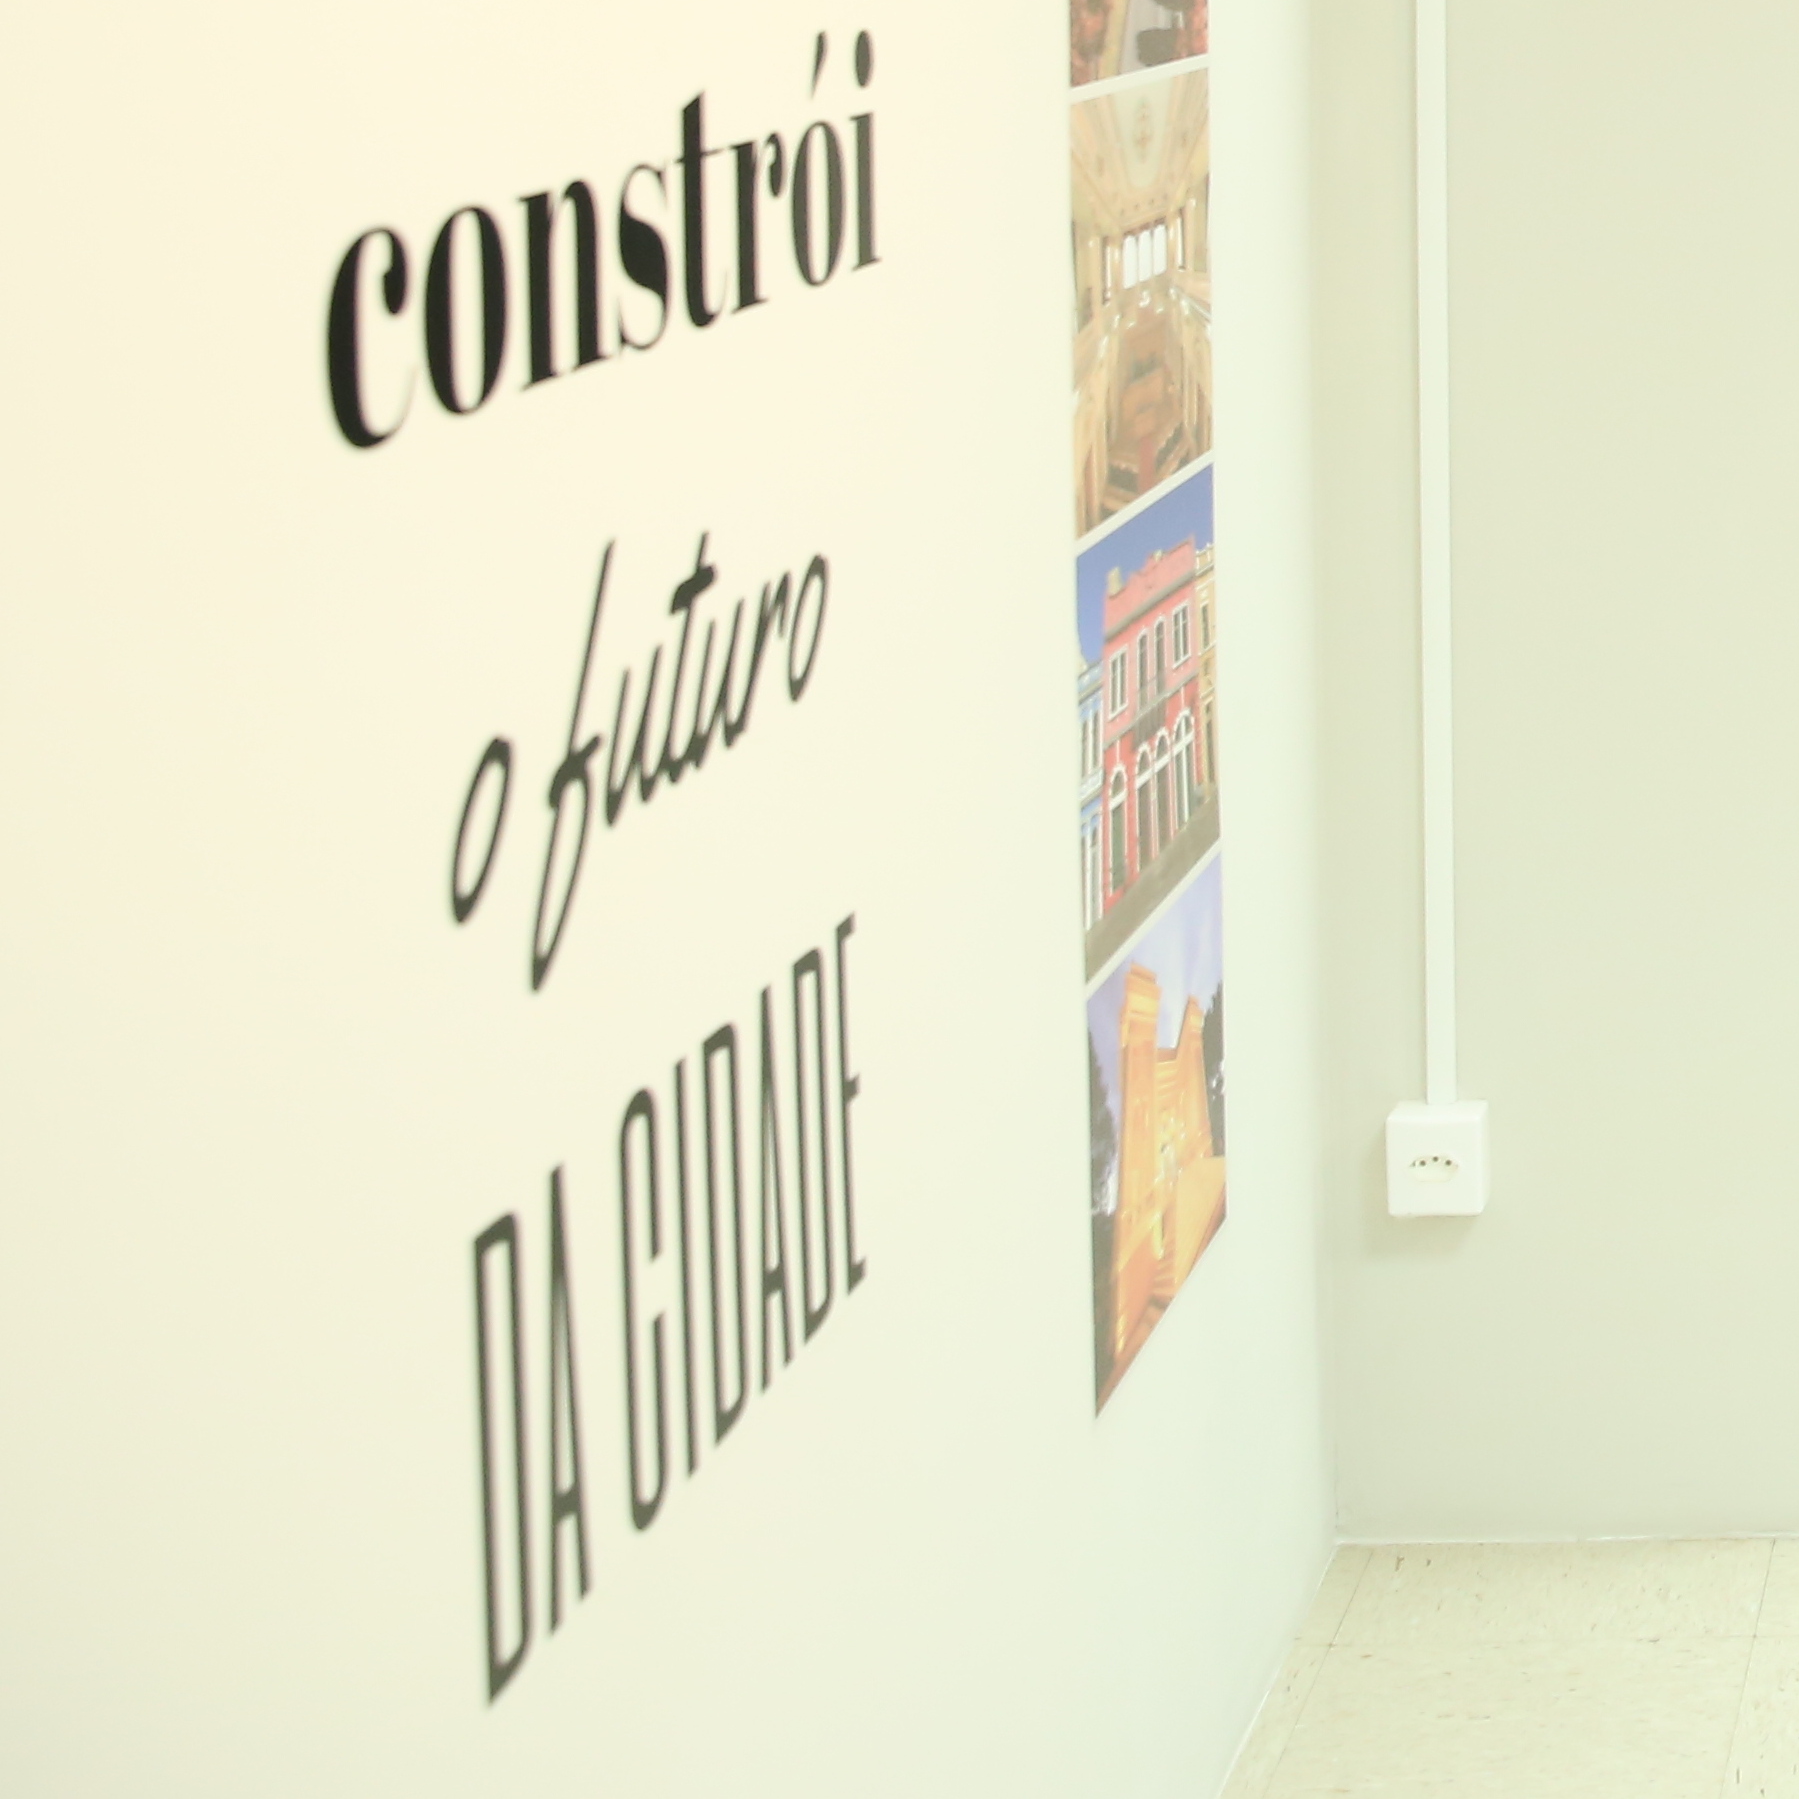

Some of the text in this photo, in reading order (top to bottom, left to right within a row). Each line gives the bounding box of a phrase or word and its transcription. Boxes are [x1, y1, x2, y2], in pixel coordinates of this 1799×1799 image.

[322, 28, 883, 453] constrói
[448, 531, 830, 995] o futuro
[471, 913, 866, 1708] DA CIDADE
